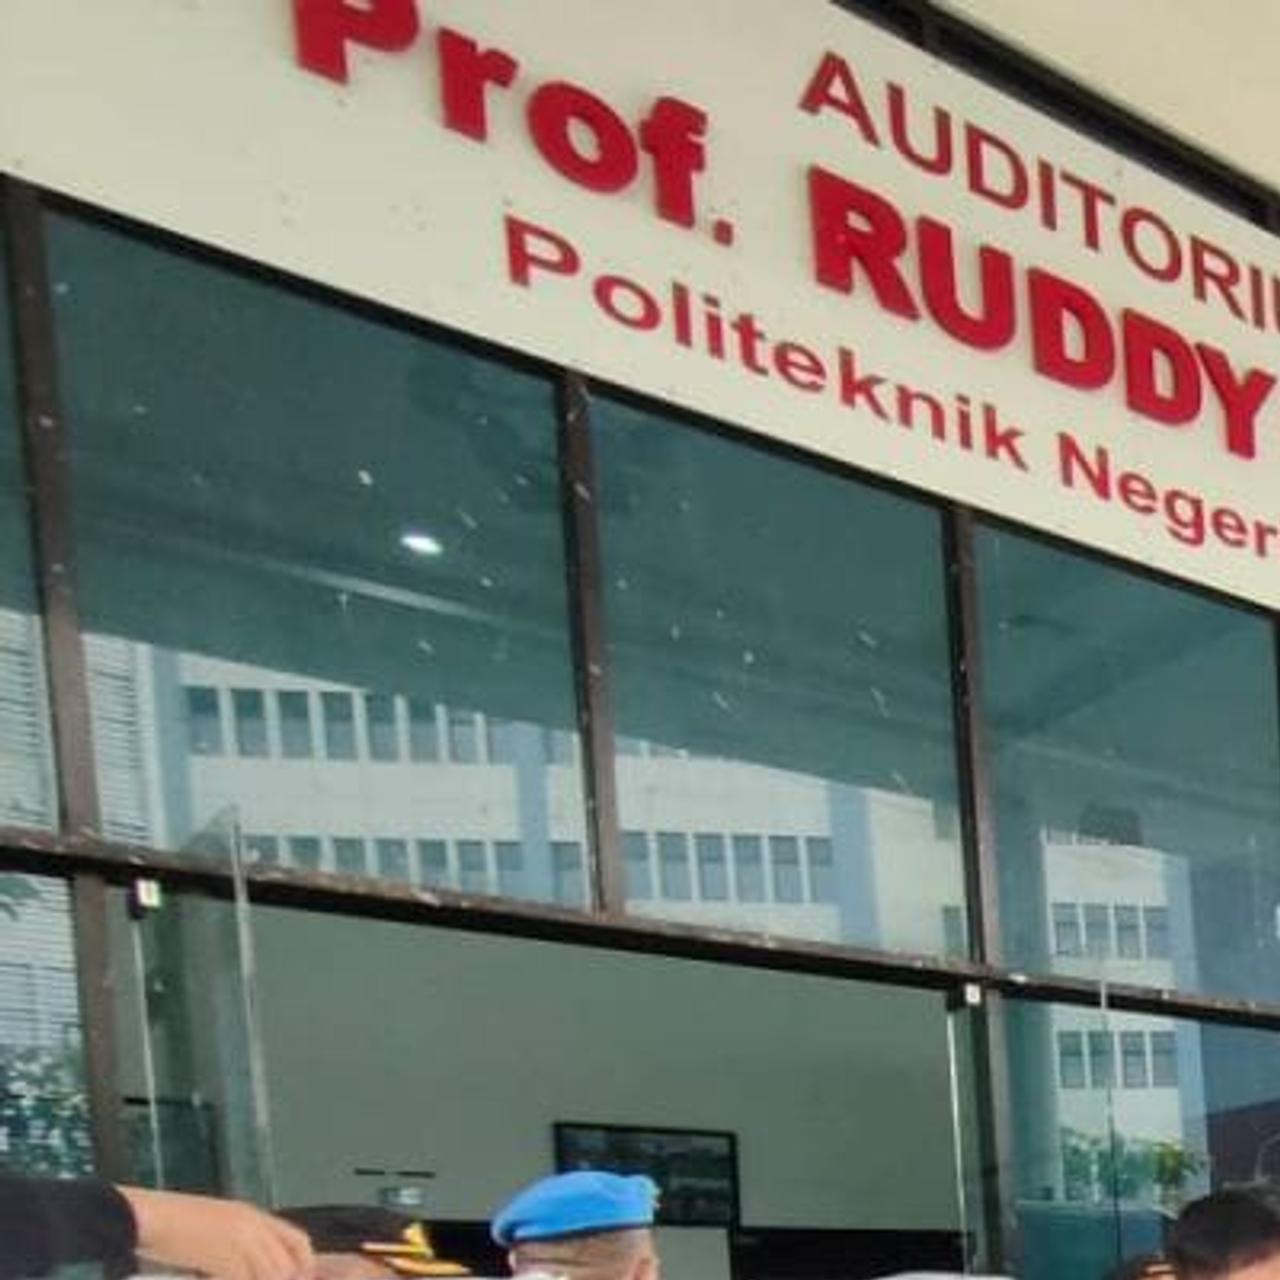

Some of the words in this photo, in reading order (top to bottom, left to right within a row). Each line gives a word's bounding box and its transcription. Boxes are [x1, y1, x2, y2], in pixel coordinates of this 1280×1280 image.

[290, 0, 734, 247] Prof.
[806, 163, 1278, 461] RUDDY
[503, 212, 1030, 474] Politeknik
